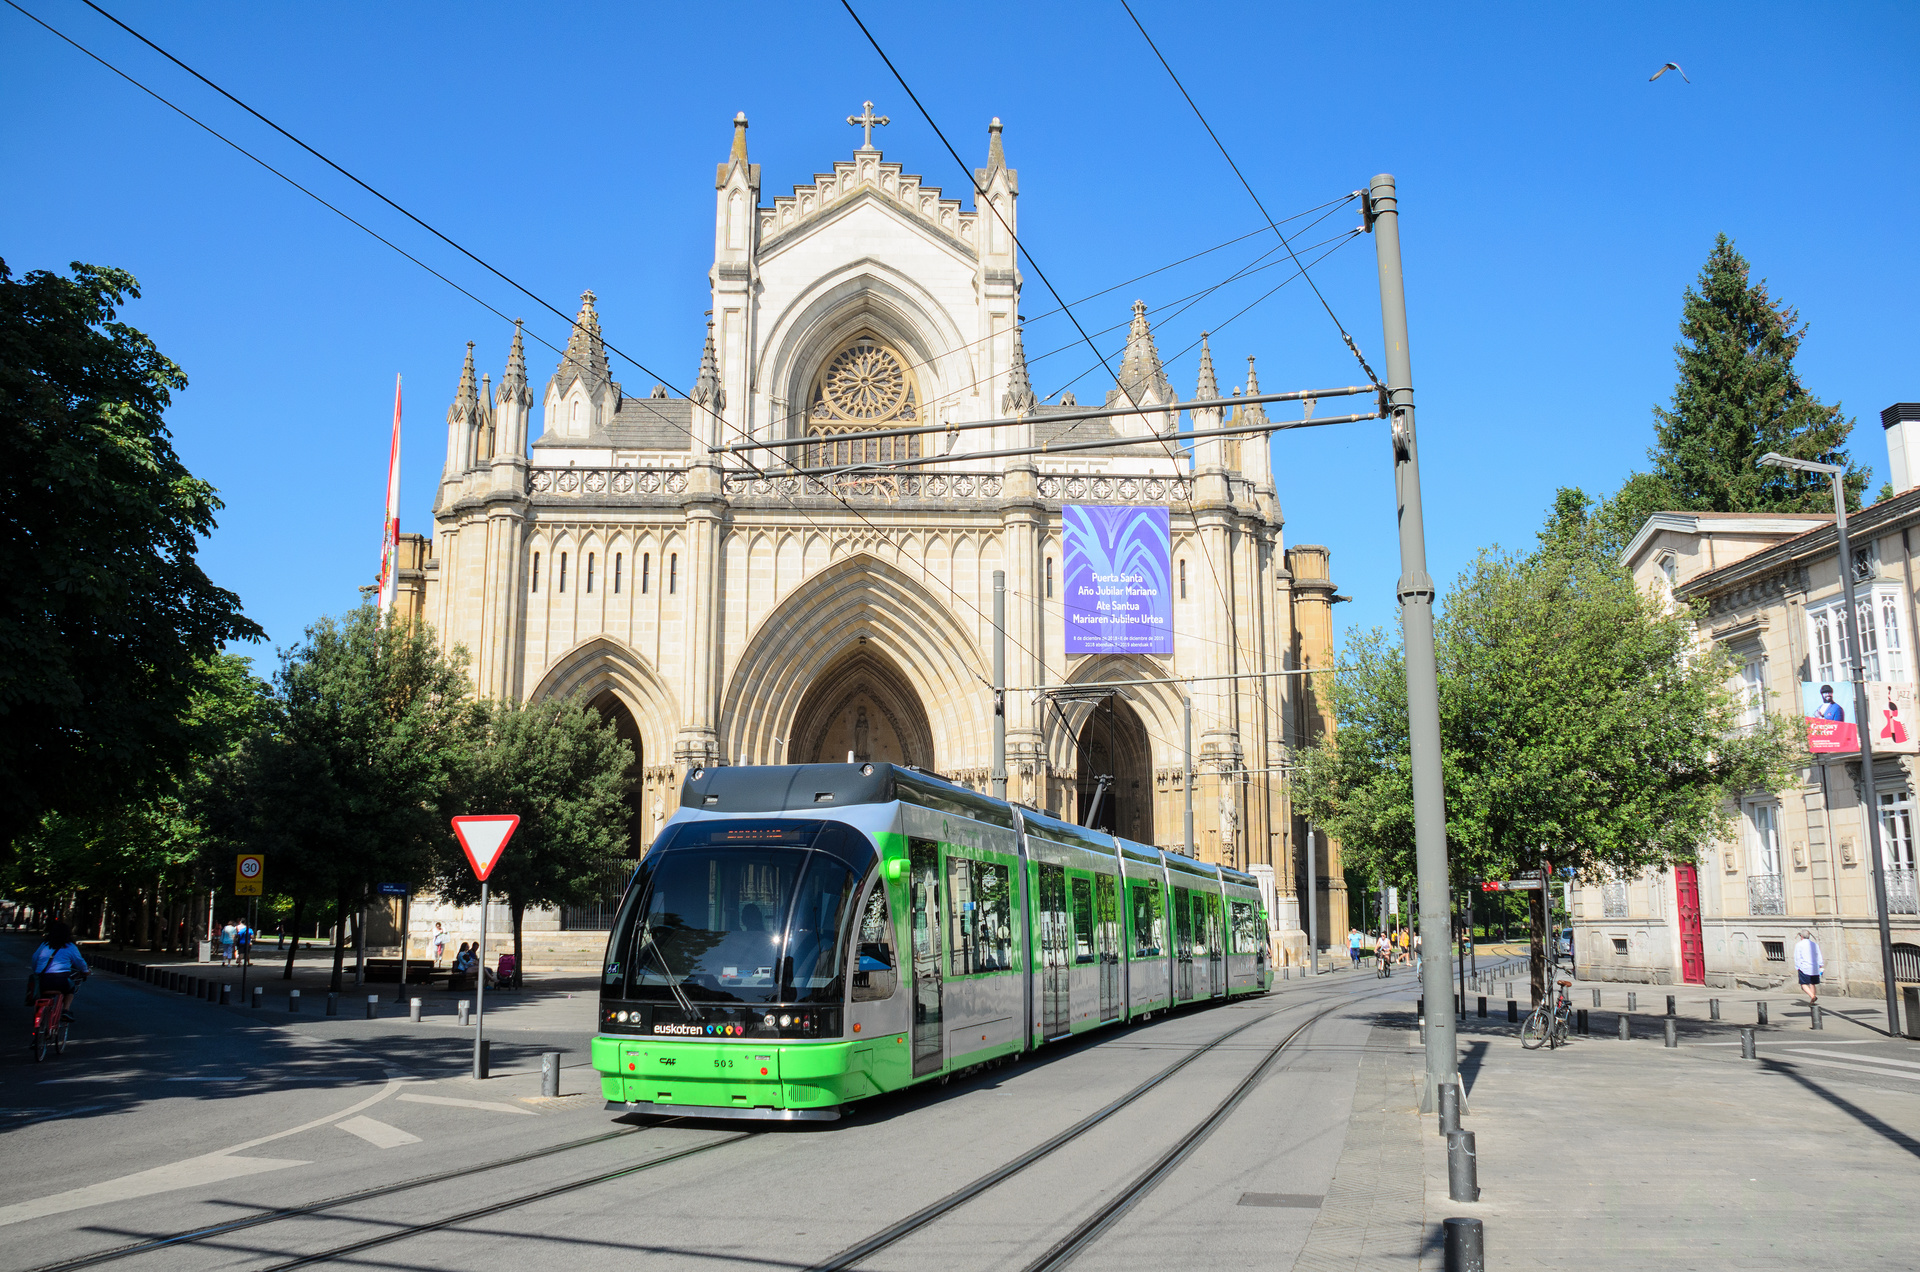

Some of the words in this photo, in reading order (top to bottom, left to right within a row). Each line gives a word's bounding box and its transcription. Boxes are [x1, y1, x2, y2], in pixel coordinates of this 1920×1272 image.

[1092, 573, 1118, 582] Puerta
[1120, 573, 1143, 582] Santa
[1078, 586, 1094, 595] Año
[1095, 586, 1124, 595] Jubilar
[1125, 586, 1157, 595] Mariano
[1096, 601, 1110, 610] Ate
[1112, 601, 1139, 610] Santua
[1073, 614, 1108, 623] Mariaren
[1110, 614, 1140, 624] Jubileu
[1141, 614, 1163, 623] Urtea
[244, 863, 257, 872] 30
[654, 1023, 703, 1035] euskotren
[714, 1060, 734, 1068] 503
